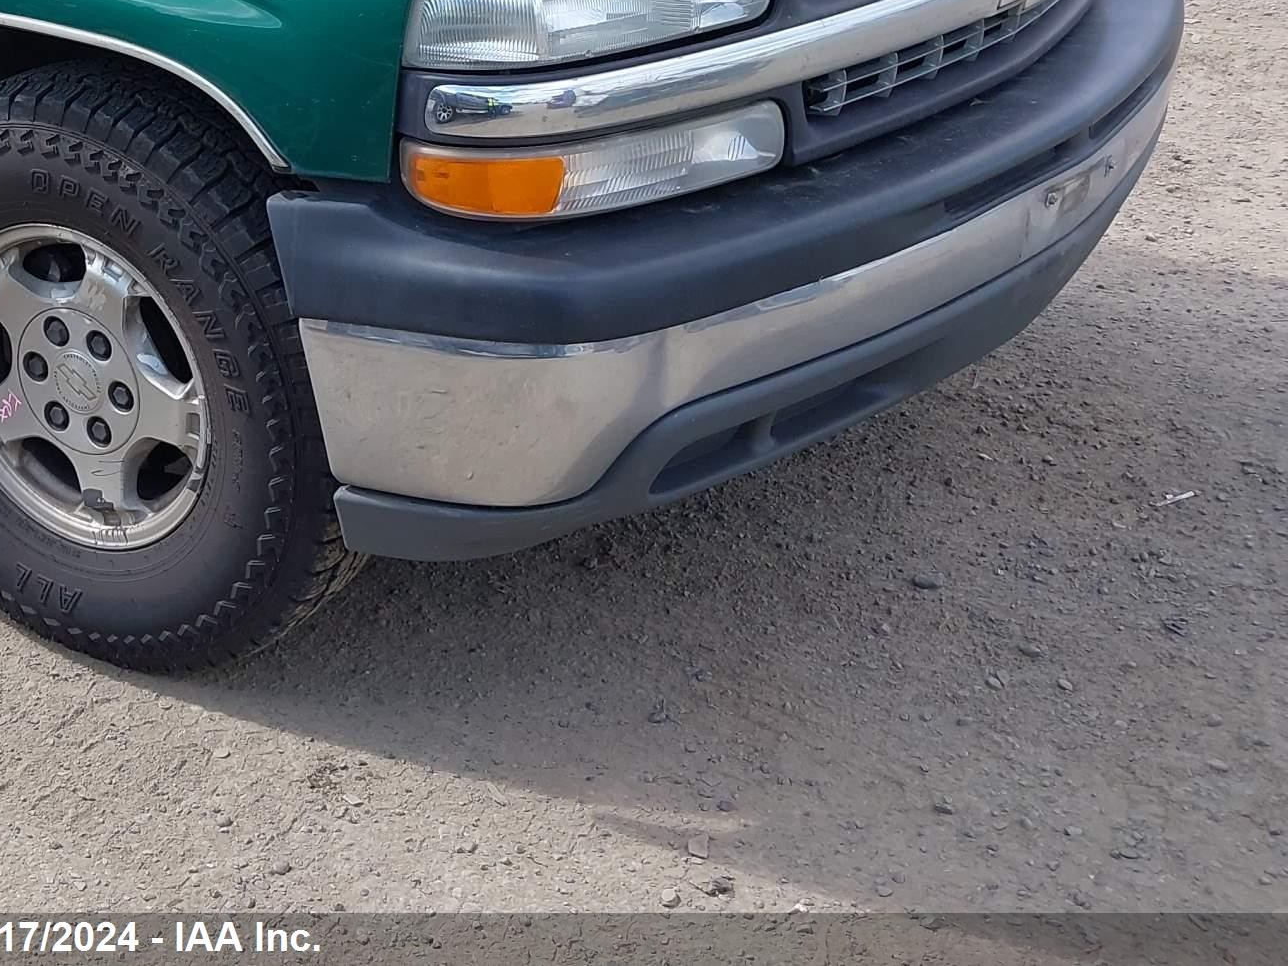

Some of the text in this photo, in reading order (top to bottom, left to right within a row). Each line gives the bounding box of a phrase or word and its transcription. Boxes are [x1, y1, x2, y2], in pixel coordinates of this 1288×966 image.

[31, 168, 142, 235] OPEN
[146, 243, 250, 415] RANGE
[15, 563, 83, 615] ALL
